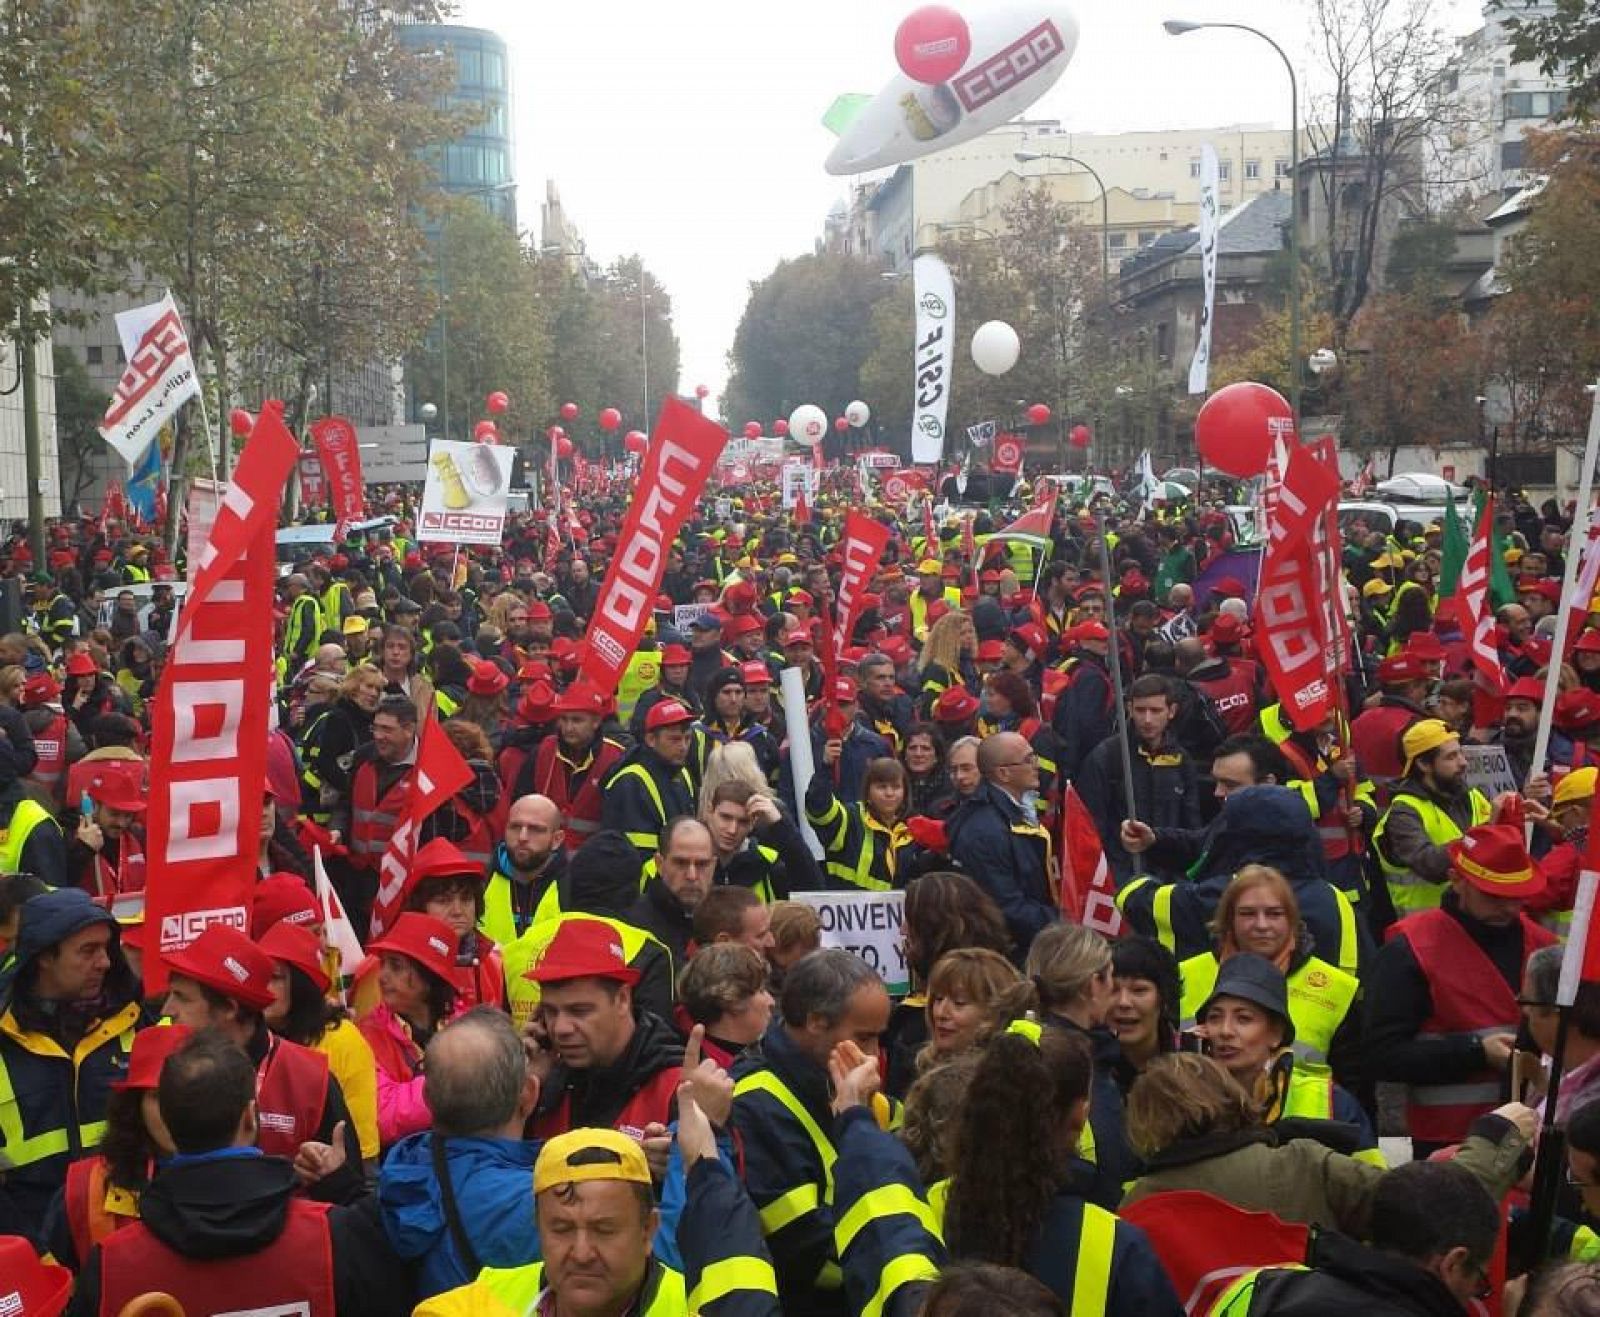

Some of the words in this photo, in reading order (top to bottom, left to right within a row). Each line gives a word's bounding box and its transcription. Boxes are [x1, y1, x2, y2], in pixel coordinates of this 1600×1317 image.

[964, 30, 1056, 103] CCOO
[447, 516, 498, 529] CCOO
[602, 439, 700, 632] CCOO
[834, 944, 887, 976] TO,
